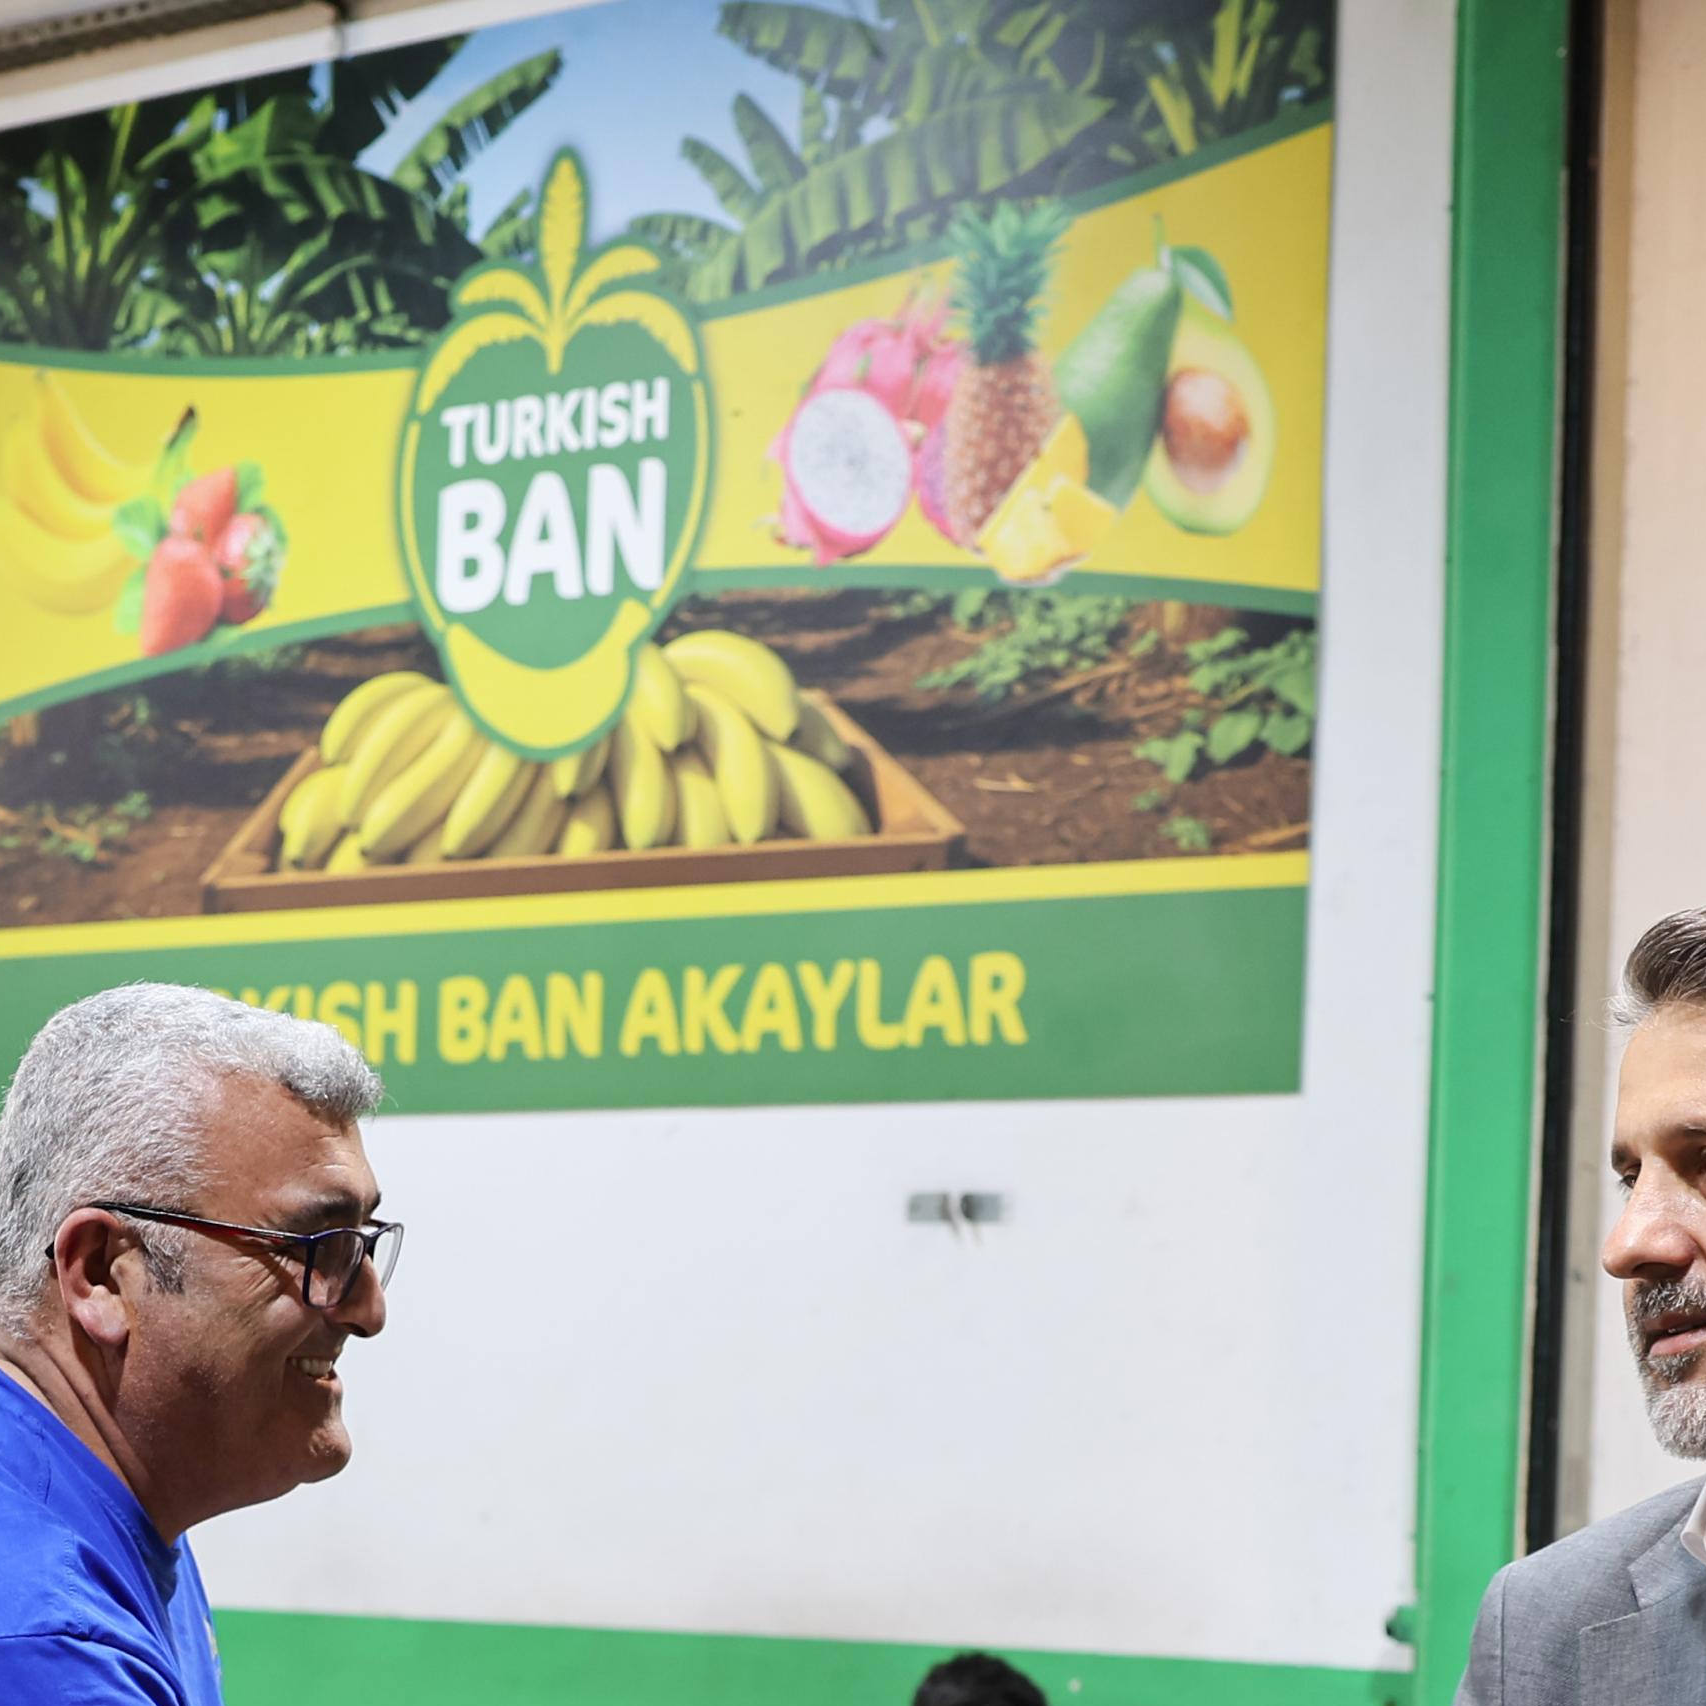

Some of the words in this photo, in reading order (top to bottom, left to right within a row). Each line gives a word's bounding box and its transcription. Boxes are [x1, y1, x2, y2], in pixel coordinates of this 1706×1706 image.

[440, 375, 671, 468] TURKISH
[436, 456, 667, 614] BAN
[438, 970, 604, 1064] BAN
[618, 950, 1029, 1058] AKAYLAR
